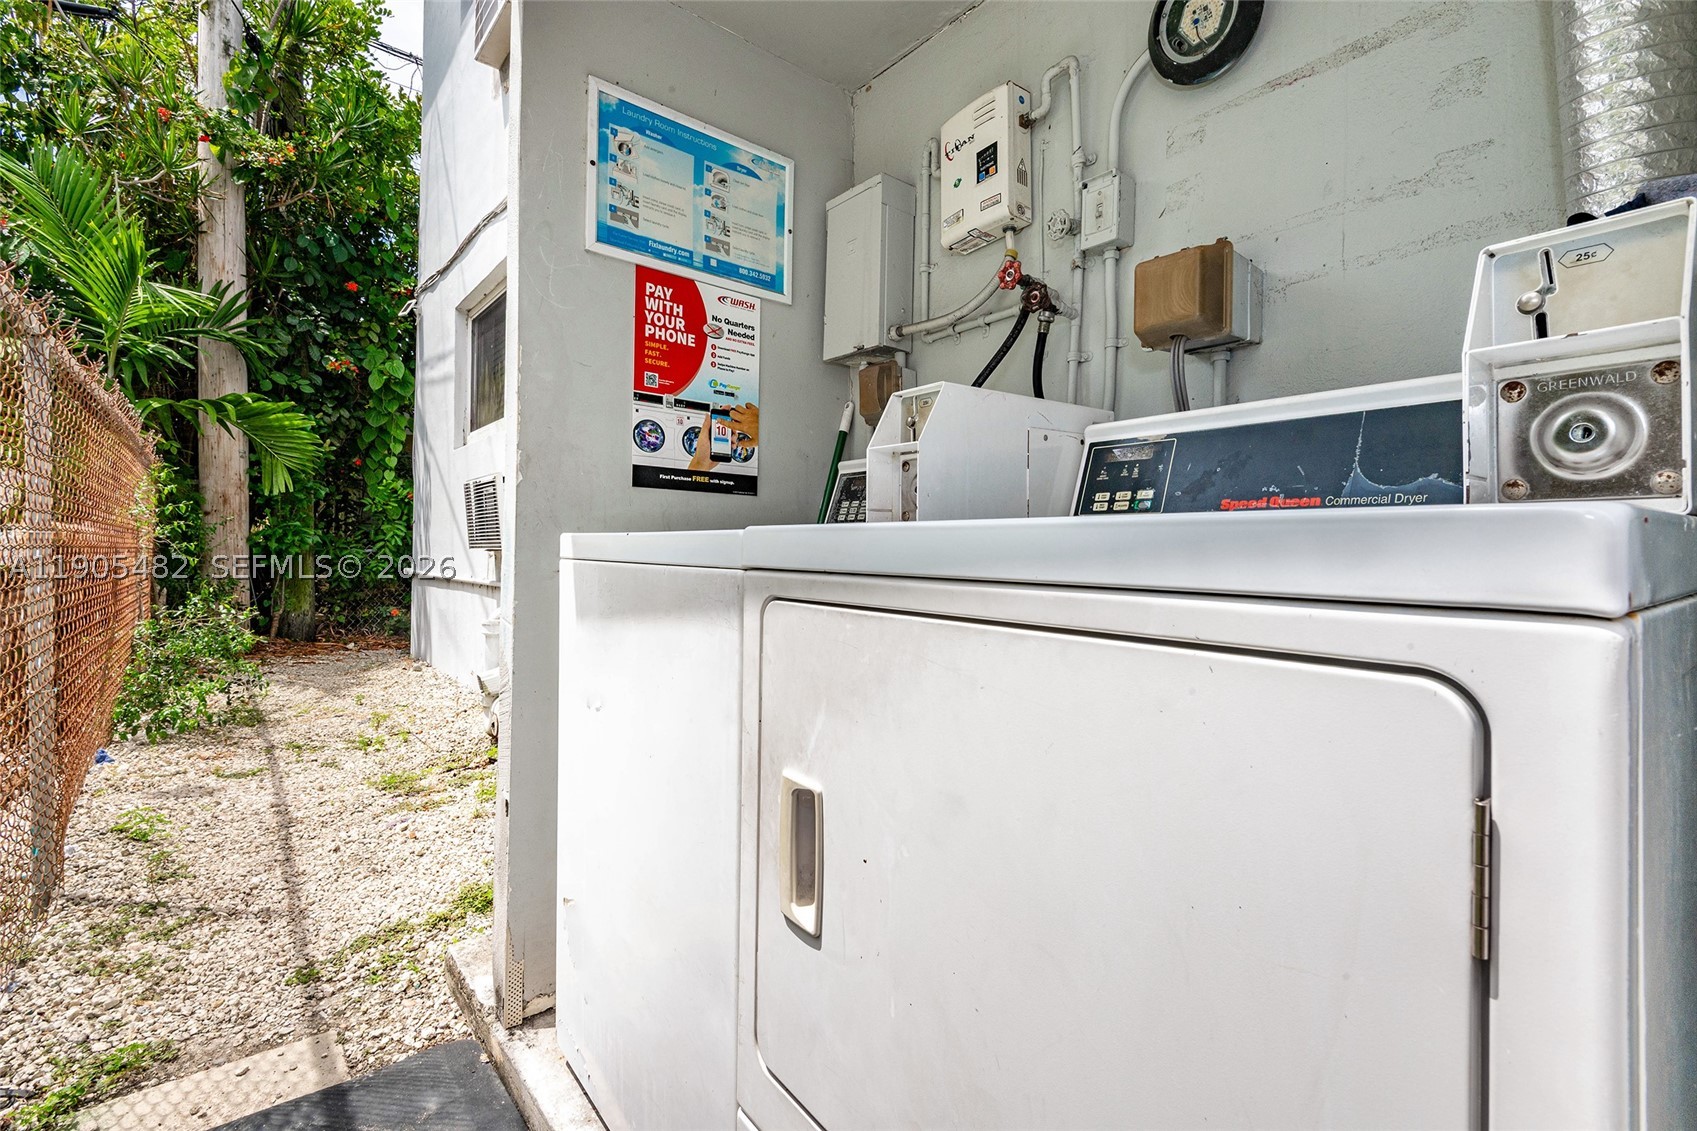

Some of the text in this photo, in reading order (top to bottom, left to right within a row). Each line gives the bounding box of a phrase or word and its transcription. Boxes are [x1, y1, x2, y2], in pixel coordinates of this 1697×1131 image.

[621, 106, 653, 126] Laundry
[654, 119, 676, 133] Room
[677, 129, 718, 151] Instructions
[648, 240, 690, 258] Fixlaundry.com
[645, 282, 673, 300] PAY
[645, 296, 684, 317] WITH
[730, 297, 756, 310] WASH
[644, 310, 686, 331] YOUR
[712, 314, 755, 331] No Quarters
[645, 324, 696, 347] PHONE
[728, 328, 755, 341] Needed
[645, 341, 669, 351] SIMPLE.
[645, 349, 662, 358] FAST.
[644, 358, 670, 368] SECURE.
[1536, 370, 1637, 393] GREENWALD
[716, 426, 727, 437] 10
[692, 475, 709, 483] FREE
[1221, 493, 1428, 511] Speed Queen Commercial Dryer
